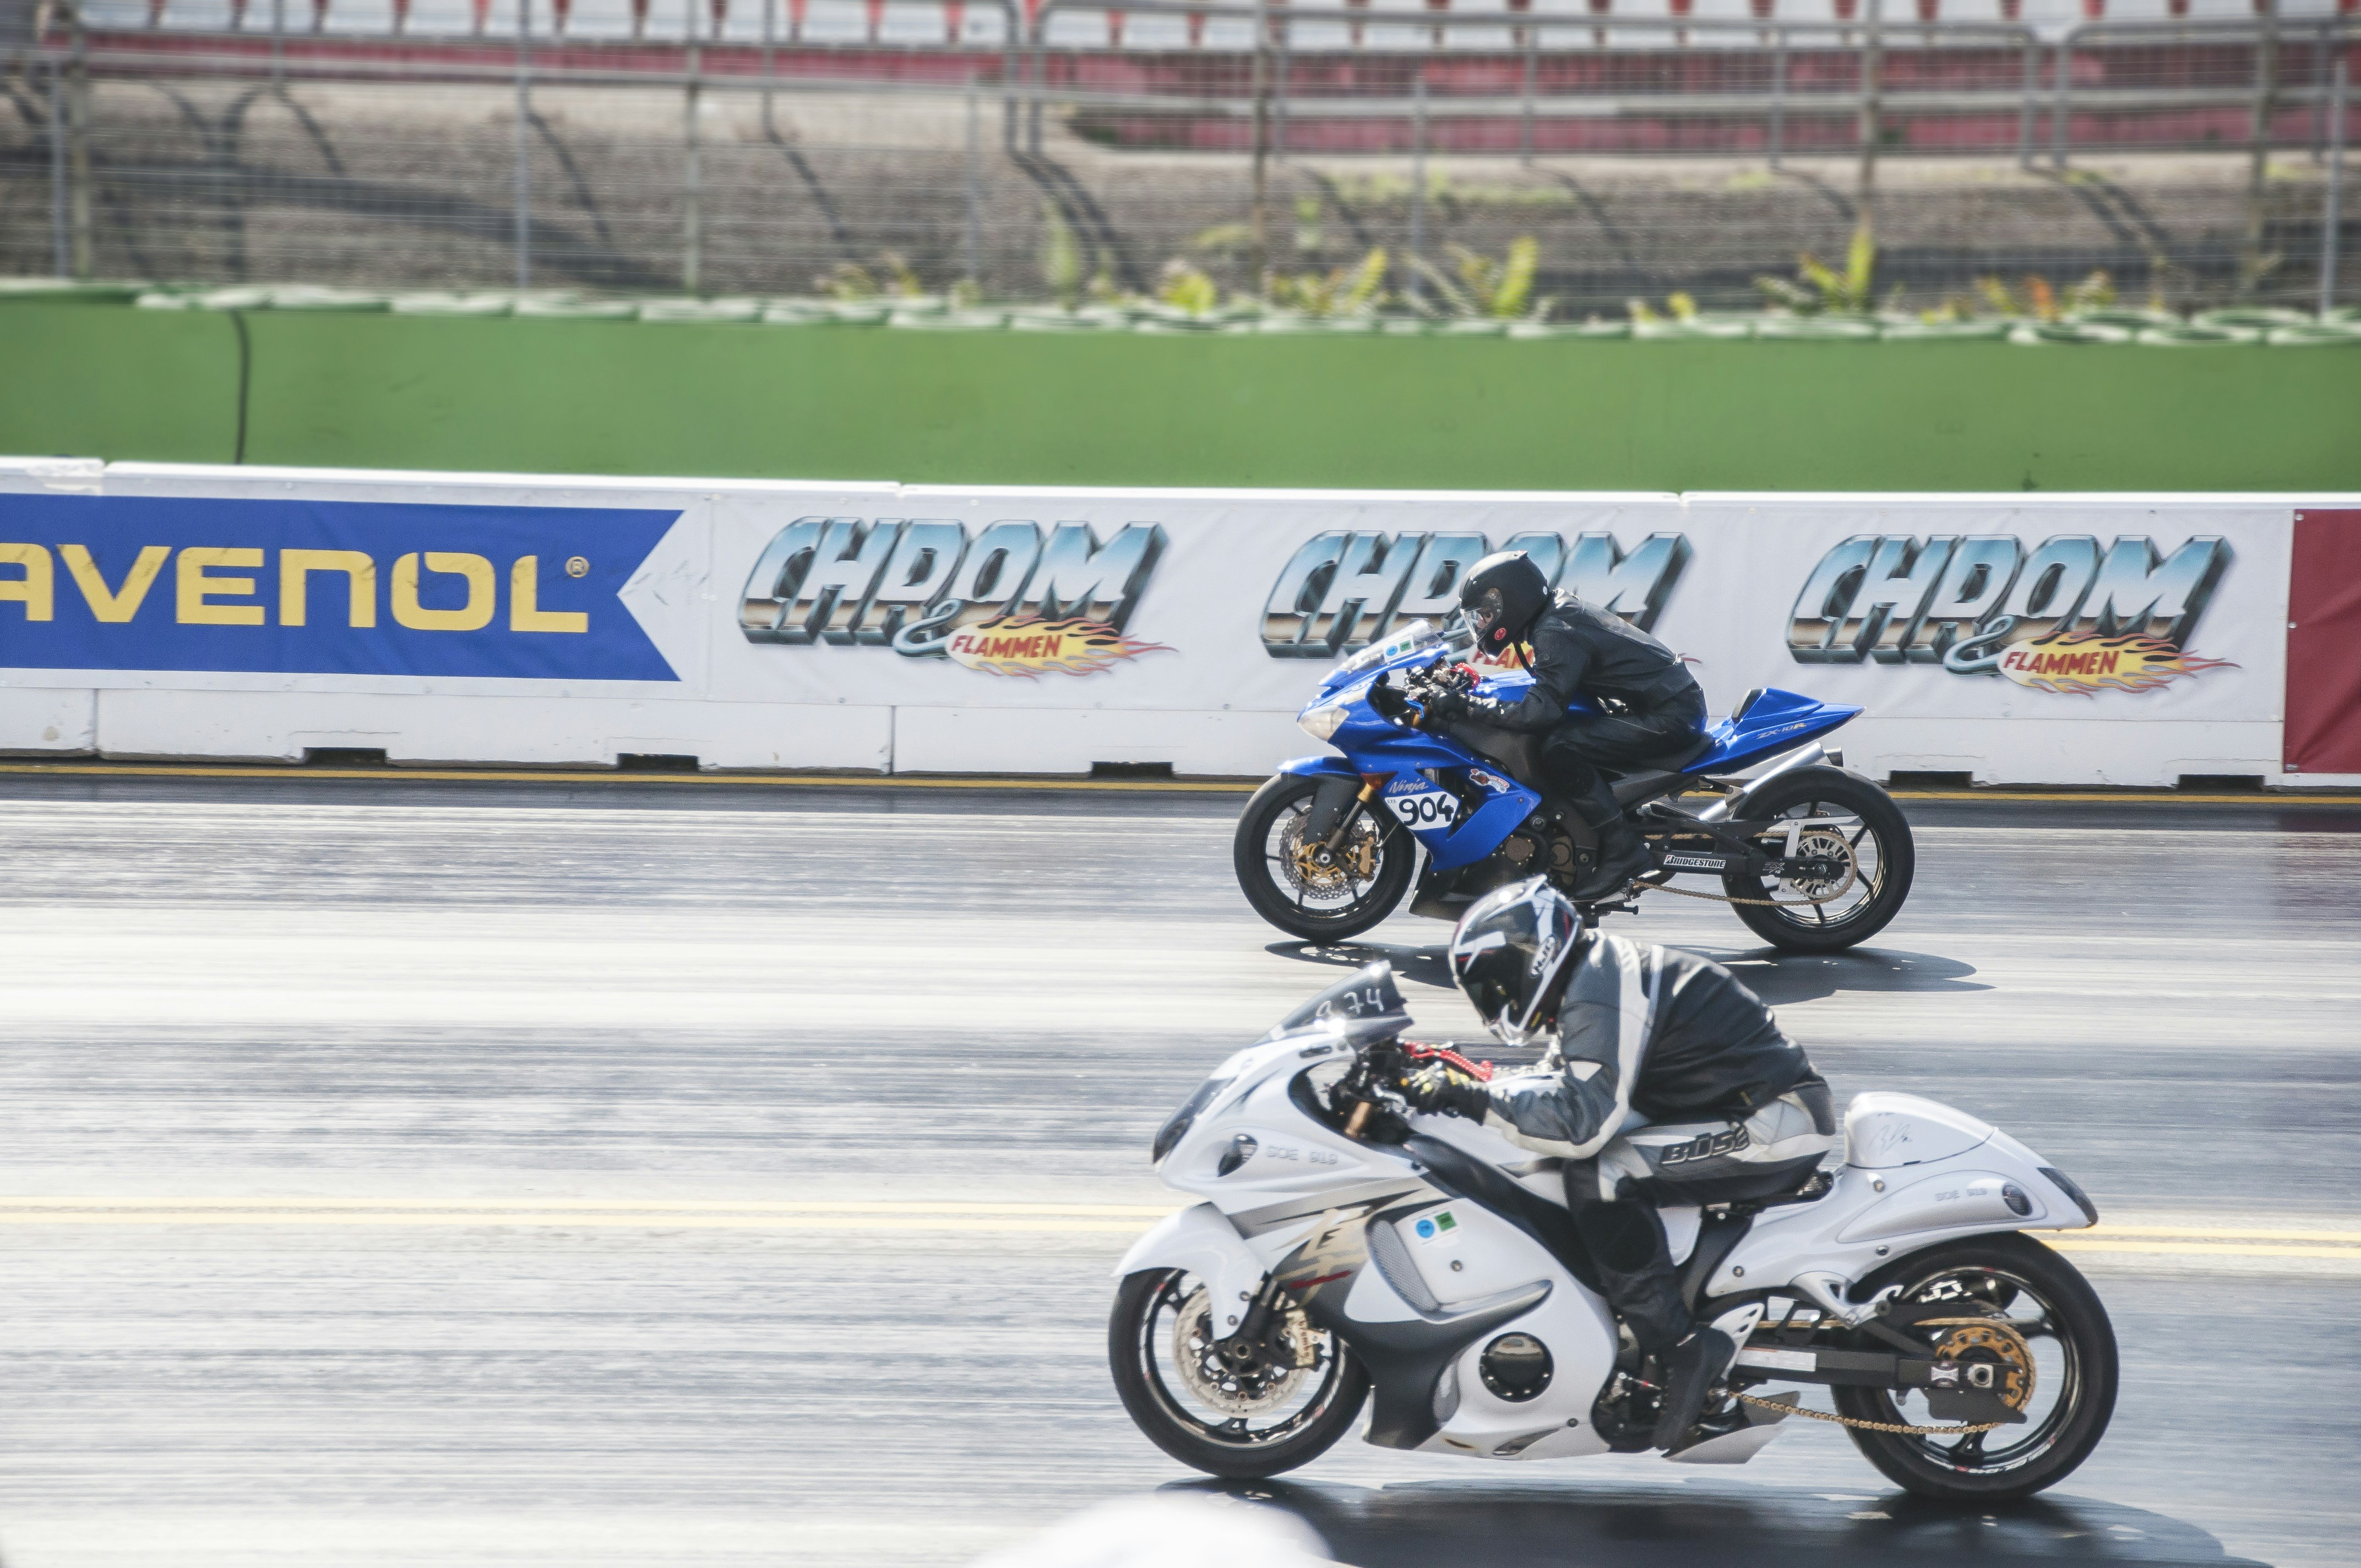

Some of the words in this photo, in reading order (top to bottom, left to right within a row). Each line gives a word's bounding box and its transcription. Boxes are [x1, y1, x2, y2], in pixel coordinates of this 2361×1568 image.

[951, 634, 1062, 658] FLAMMEN
[2003, 650, 2120, 675] FLAMMEN
[1388, 778, 1429, 793] Ninja
[1399, 793, 1454, 826] 904
[1665, 855, 1726, 868] BRIDGESTONE
